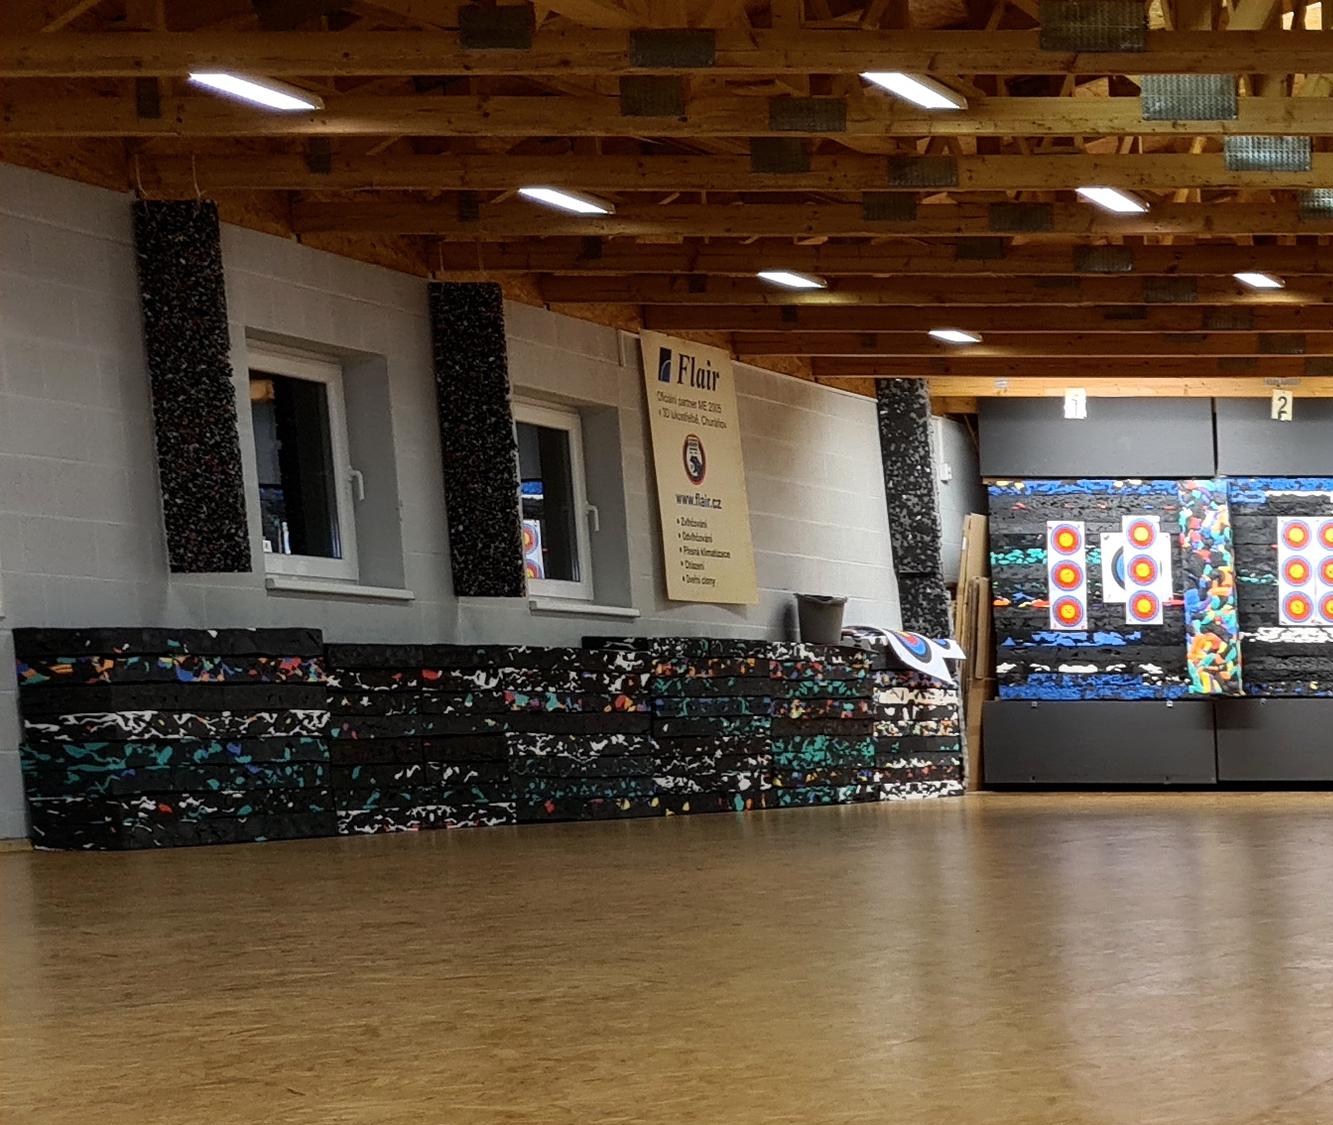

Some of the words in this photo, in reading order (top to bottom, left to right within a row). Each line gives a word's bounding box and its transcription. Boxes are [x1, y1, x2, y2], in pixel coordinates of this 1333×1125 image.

[677, 353, 720, 391] Flair
[1277, 396, 1288, 411] 2
[676, 492, 722, 510] www.flair.cz
